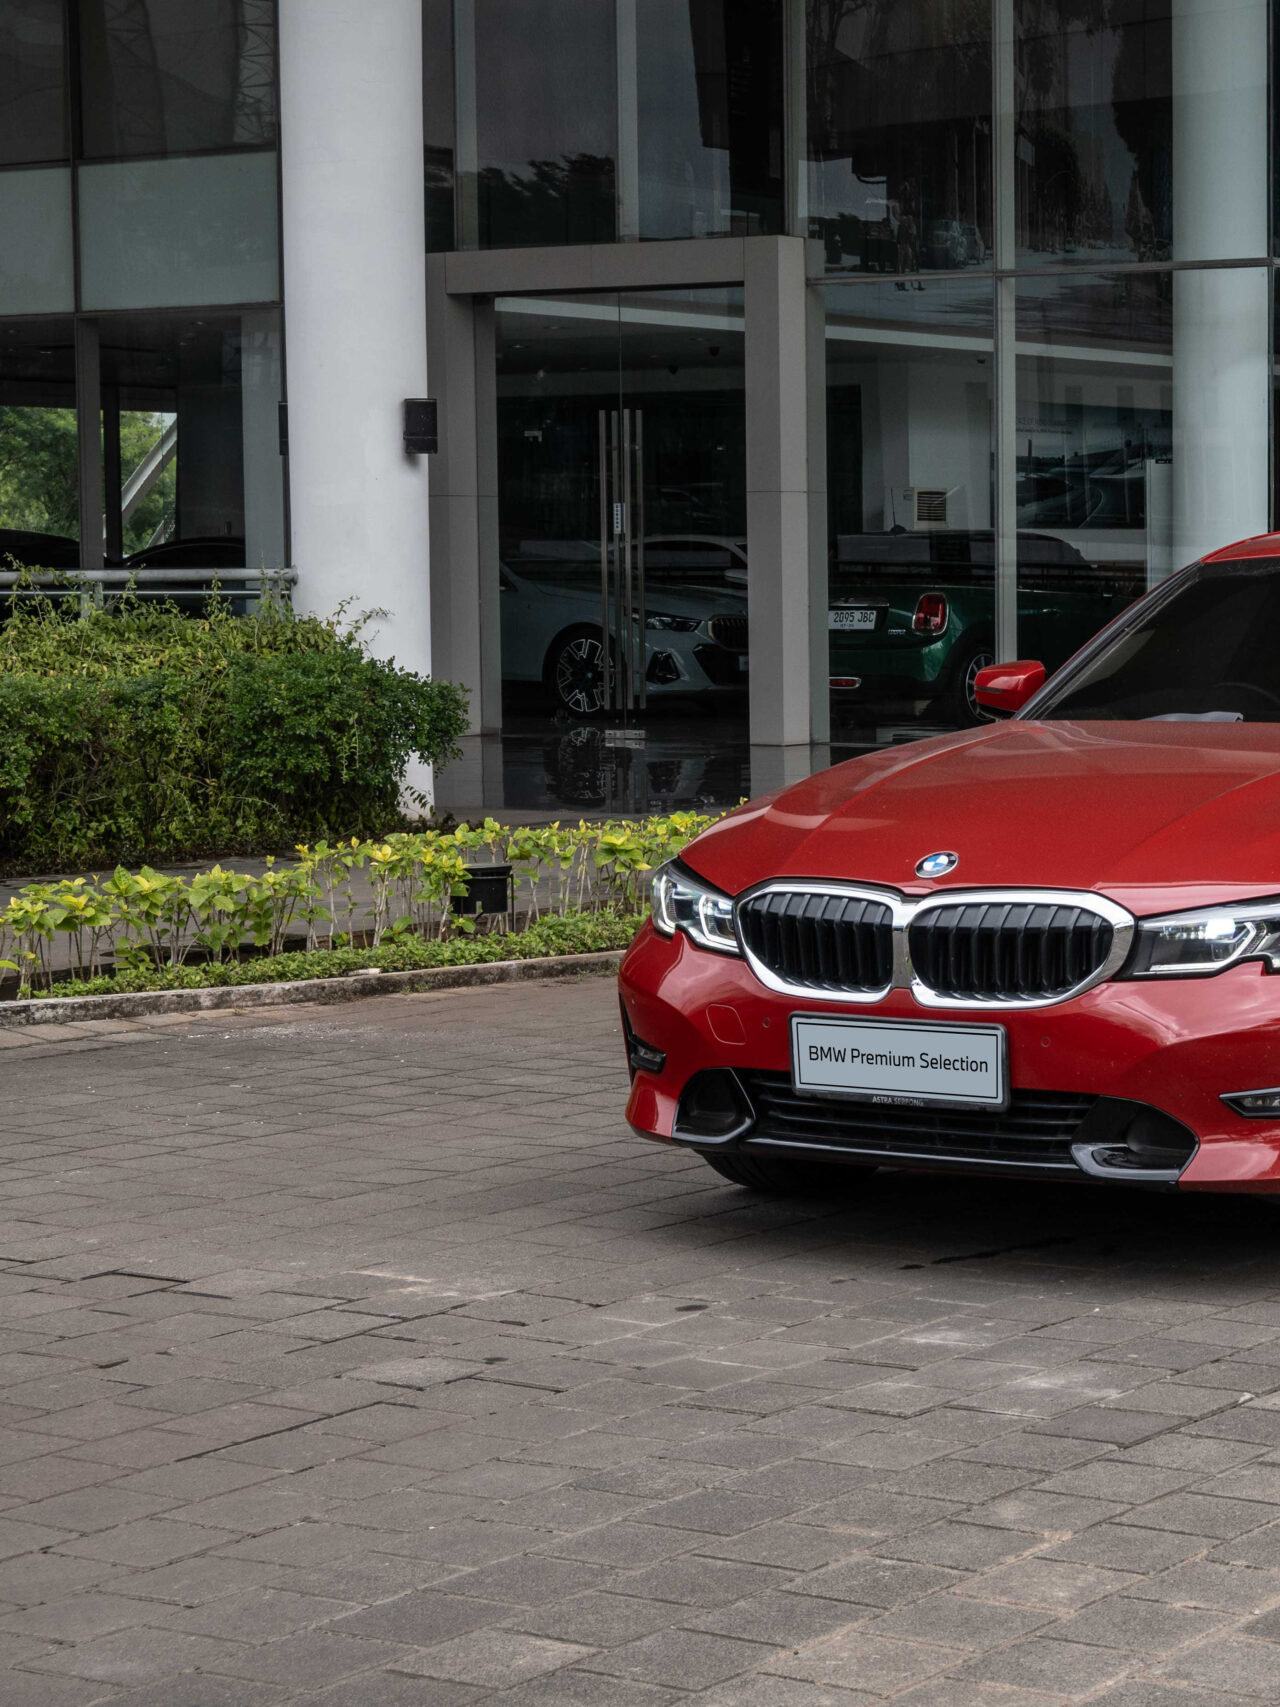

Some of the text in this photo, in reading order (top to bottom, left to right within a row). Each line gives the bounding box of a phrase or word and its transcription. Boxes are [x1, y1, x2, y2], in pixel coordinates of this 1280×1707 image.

[833, 611, 875, 623] 2095 JBC
[809, 1045, 989, 1073] BMW Premium Selection
[872, 1095, 892, 1105] ASTRA
